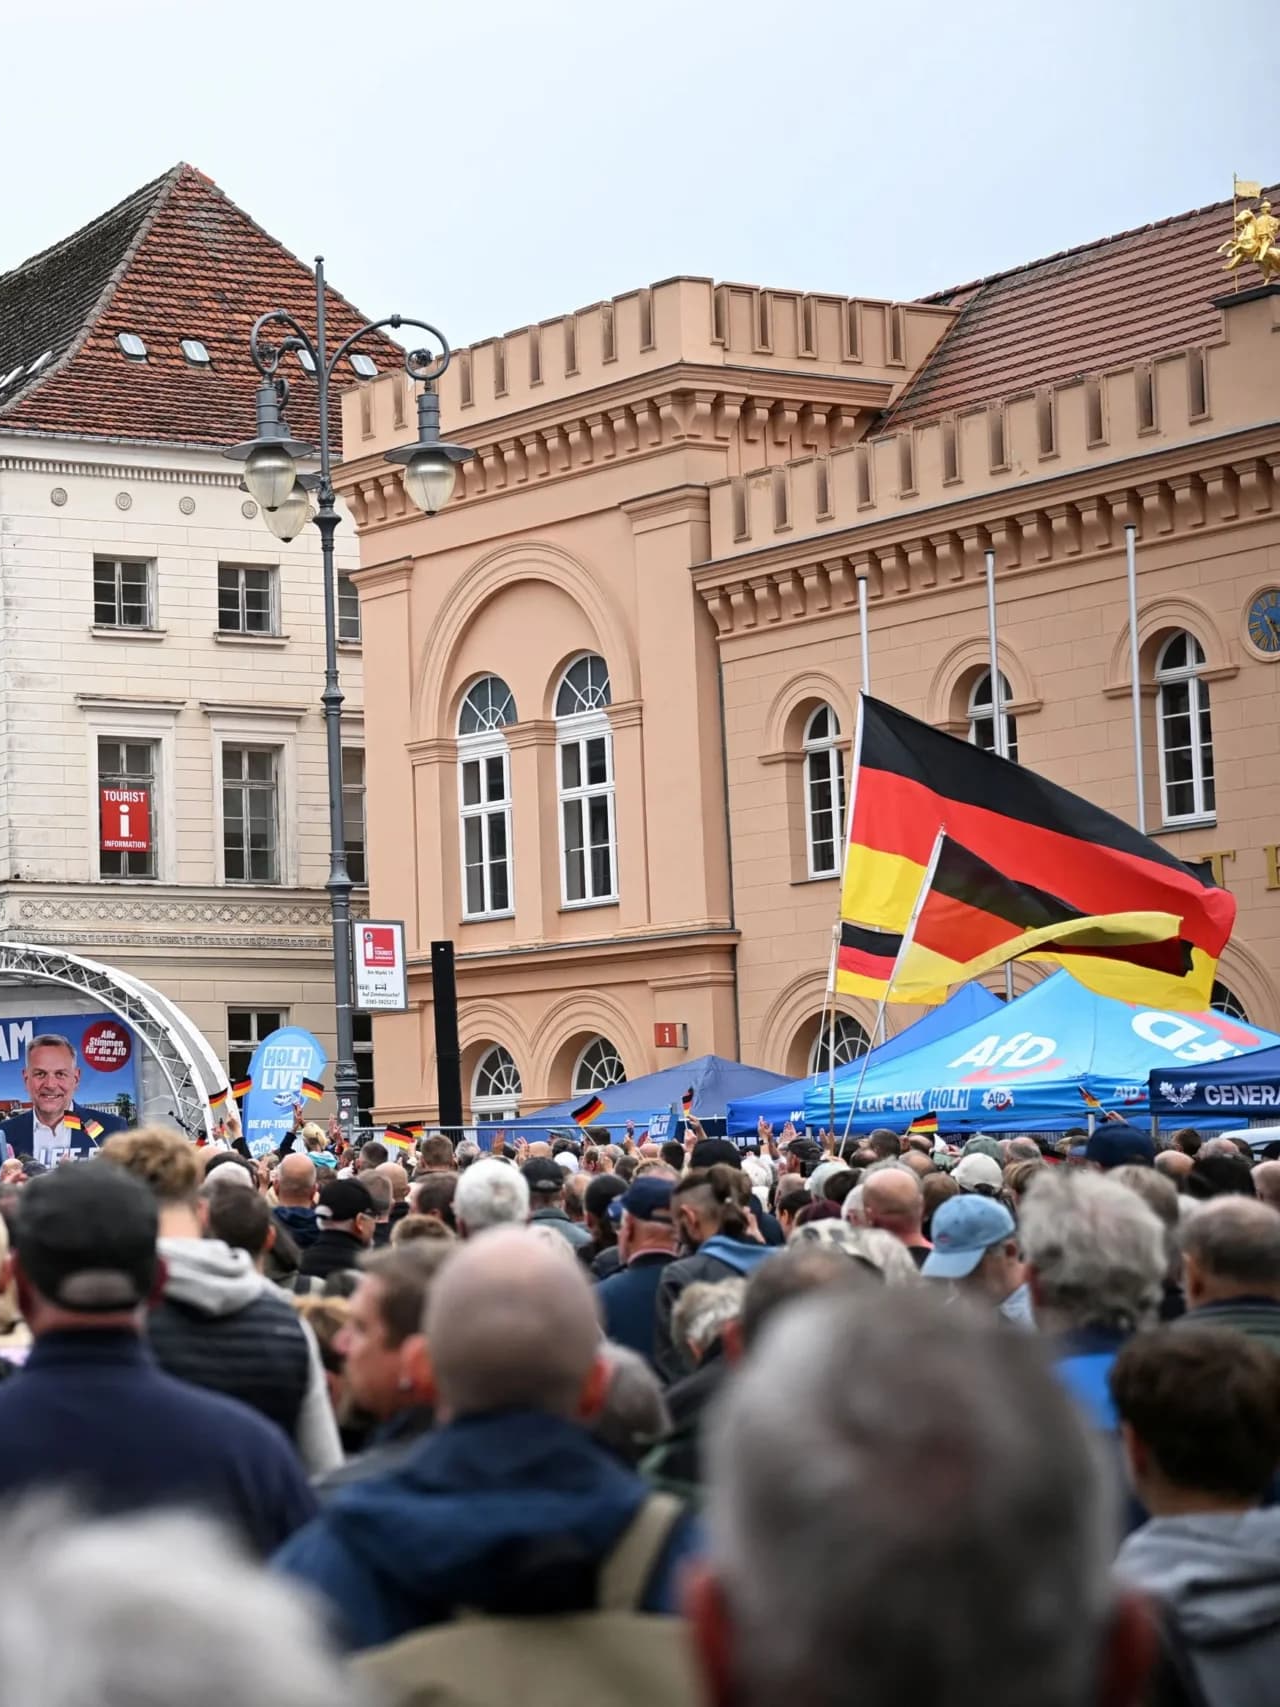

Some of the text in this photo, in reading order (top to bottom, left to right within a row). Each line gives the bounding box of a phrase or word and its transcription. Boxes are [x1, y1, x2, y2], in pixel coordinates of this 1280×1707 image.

[104, 790, 145, 803] TOURIST
[104, 840, 147, 848] INFORMATION
[101, 1030, 116, 1039] Alle
[1131, 1011, 1244, 1062] fD
[89, 1037, 124, 1047] Stimmen
[98, 1047, 111, 1055] die
[112, 1048, 127, 1056] AfD
[946, 1031, 1058, 1069] AfD
[264, 1048, 312, 1067] HOLM
[930, 1087, 969, 1110] HOLM
[988, 1092, 1006, 1105] AfD
[1114, 1086, 1140, 1098] AfD
